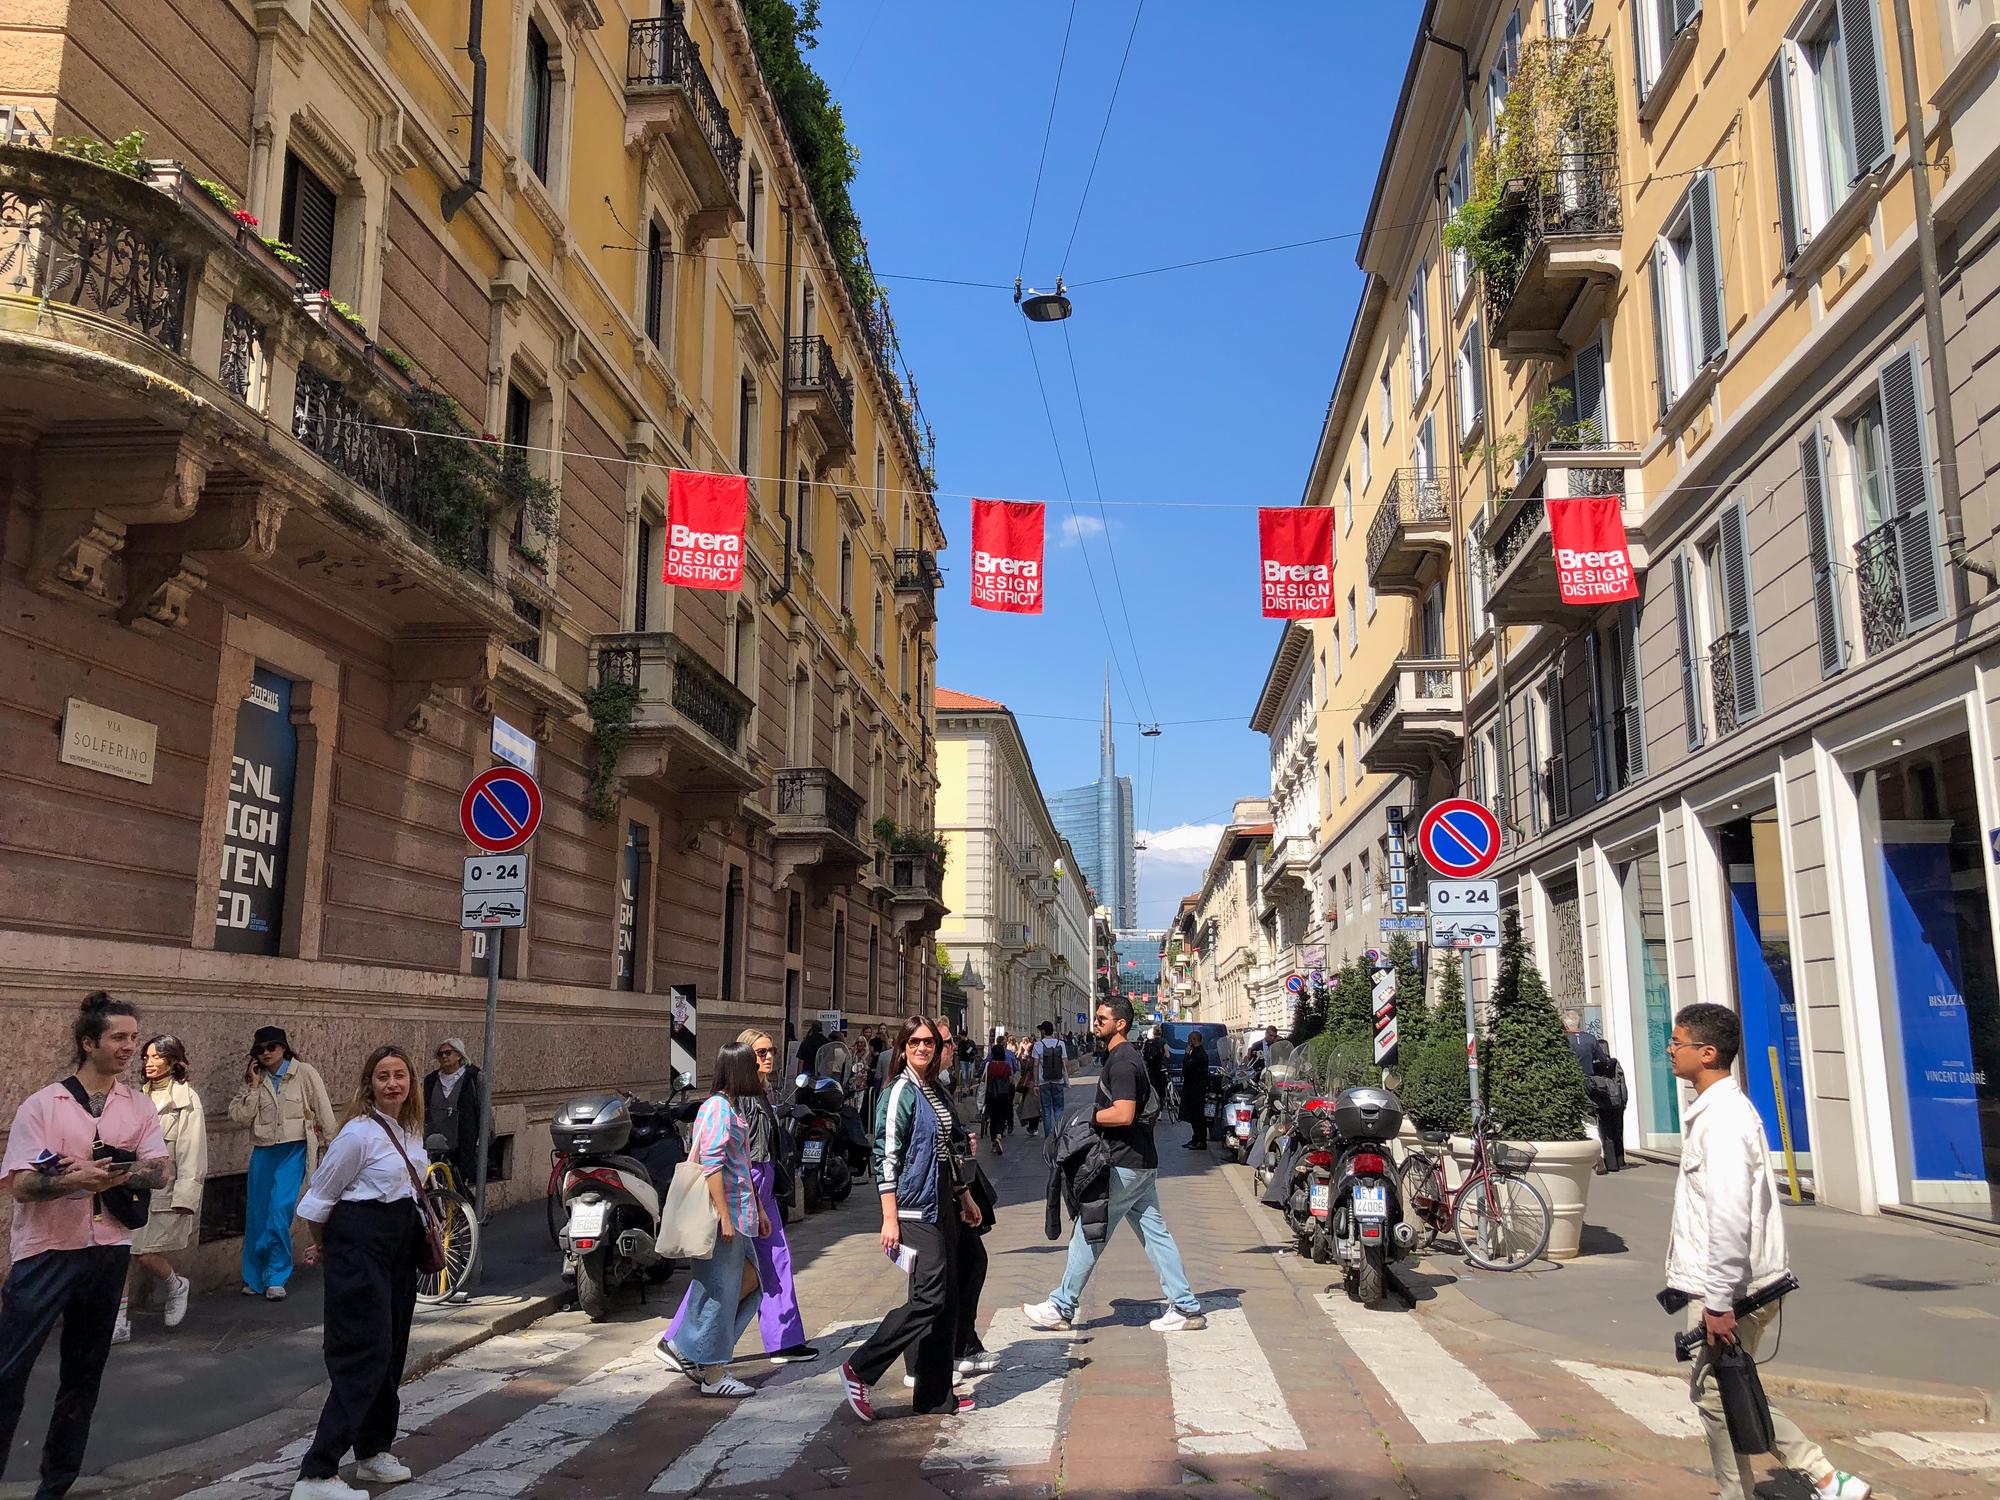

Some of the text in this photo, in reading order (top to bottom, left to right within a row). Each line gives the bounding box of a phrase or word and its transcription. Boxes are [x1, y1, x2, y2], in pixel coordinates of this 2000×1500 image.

[671, 524, 738, 552] Brera
[668, 549, 738, 567] DESIGN
[975, 550, 1038, 577] Brera
[1558, 549, 1625, 569] Brera
[667, 563, 737, 581] DISTRICT
[1264, 560, 1328, 581] Brera
[1561, 565, 1628, 583] DESIGN
[974, 573, 1038, 591] DESIGN
[1265, 583, 1329, 596] DESIGN
[1563, 579, 1629, 596] DISTRICT
[974, 587, 1038, 605] DISTRICT
[1265, 597, 1329, 610] DISTRICT
[107, 720, 121, 732] VIA
[74, 732, 147, 764] SOLFERINO
[230, 755, 280, 803] ENL
[1388, 808, 1404, 913] PHILIPS
[496, 864, 518, 880] 24
[1465, 889, 1489, 903] 24
[1928, 994, 1965, 1007] BISAZZA
[1925, 1071, 1958, 1083] VINCENT
[1357, 1201, 1384, 1213] 44006
